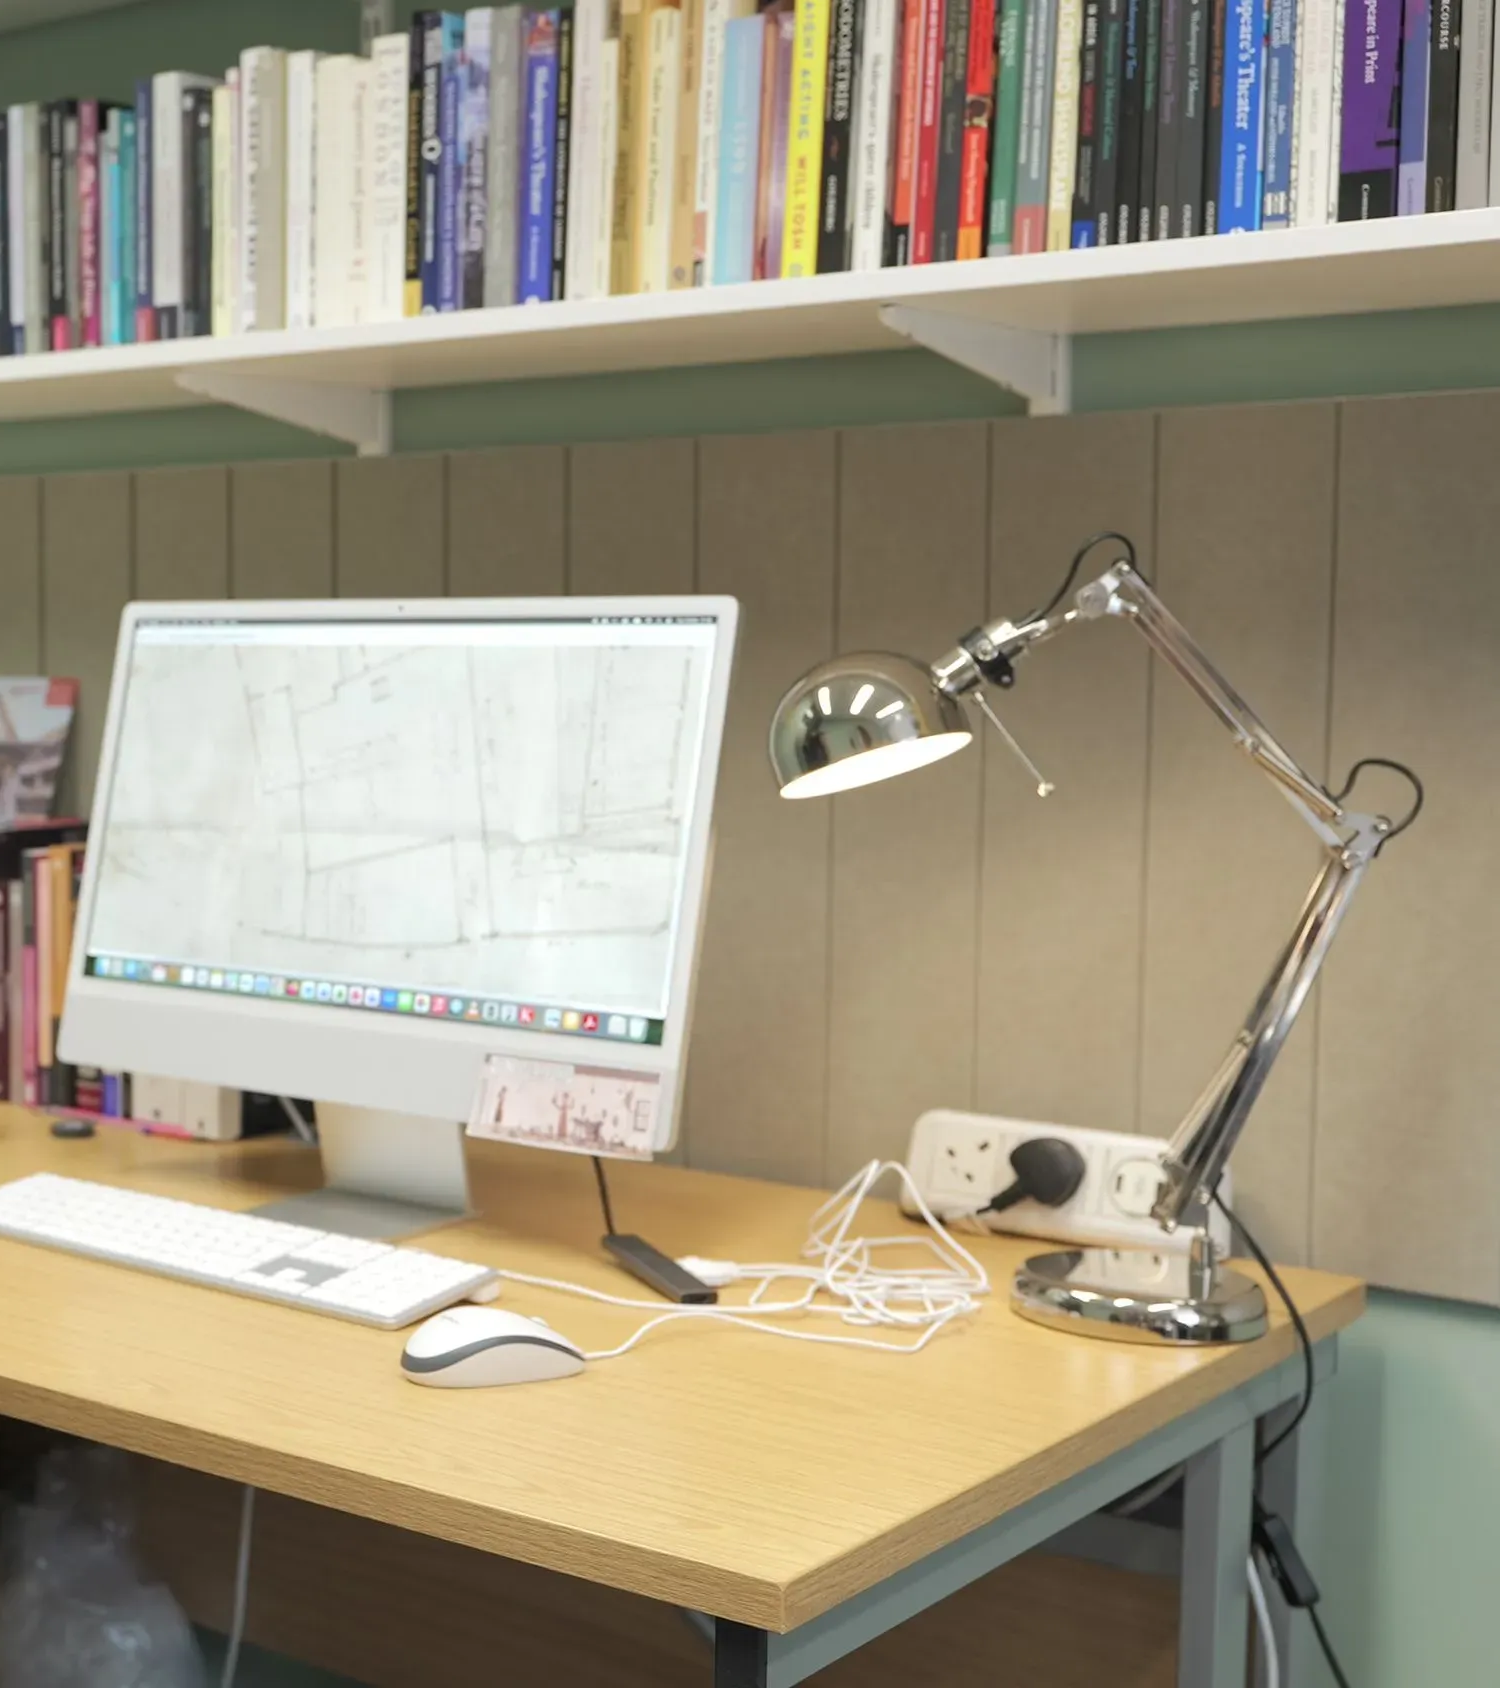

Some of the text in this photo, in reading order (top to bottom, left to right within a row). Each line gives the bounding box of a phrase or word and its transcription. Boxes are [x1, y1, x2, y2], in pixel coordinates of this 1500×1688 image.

[1363, 0, 1379, 85] peare in Print
[795, 67, 812, 141] ACTING
[1233, 62, 1254, 131] Theater
[791, 153, 808, 198] WILL
